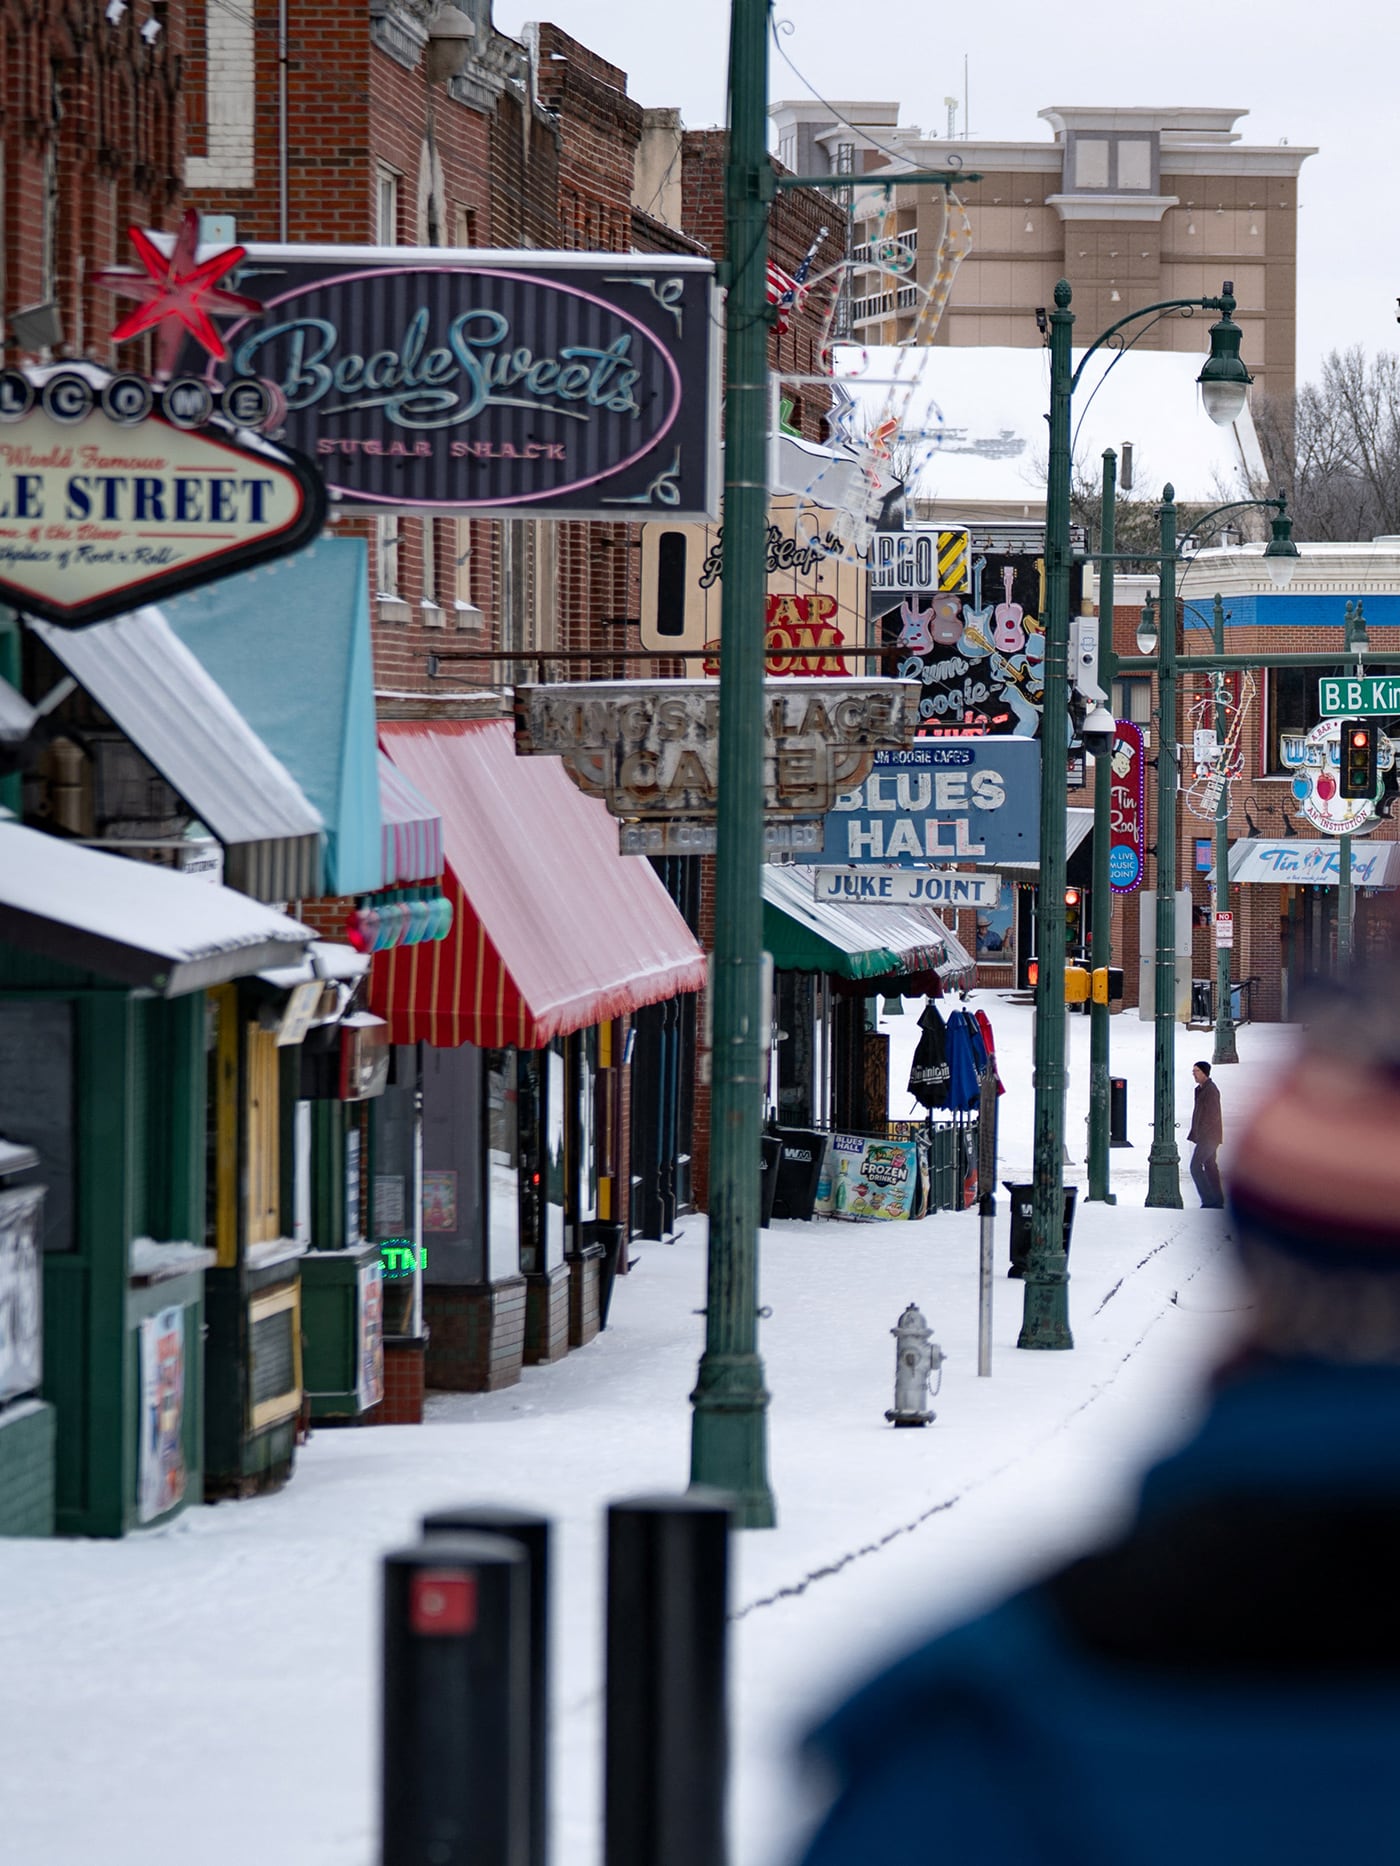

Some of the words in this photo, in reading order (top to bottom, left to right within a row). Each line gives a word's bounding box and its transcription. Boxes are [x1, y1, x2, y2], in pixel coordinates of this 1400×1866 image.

[235, 307, 458, 410] Beale
[388, 309, 641, 428] Sweets
[317, 437, 433, 457] SUGAR
[450, 441, 567, 462] SHACK
[65, 475, 275, 524] STREET
[706, 629, 842, 671] ROM
[914, 678, 990, 721] oogie
[1325, 683, 1369, 711] B.B.
[706, 694, 900, 742] LACE
[875, 751, 890, 764] UM
[620, 749, 820, 800] CAE
[832, 770, 1007, 812] BLUES
[1111, 786, 1138, 811] Tin
[677, 825, 819, 850] CONONED
[848, 818, 987, 859] HALL
[1110, 809, 1140, 843] Roof
[1110, 861, 1136, 870] MUSIC
[1119, 853, 1135, 862] LIVE
[1259, 849, 1300, 871] Tin
[1110, 870, 1135, 879] JOINT
[827, 874, 894, 898] JUKE
[909, 878, 987, 902] JOINT
[835, 1136, 864, 1146] BLUES
[836, 1143, 860, 1152] HALL
[861, 1162, 908, 1181] FROZEN
[868, 1174, 898, 1185] DRINKS
